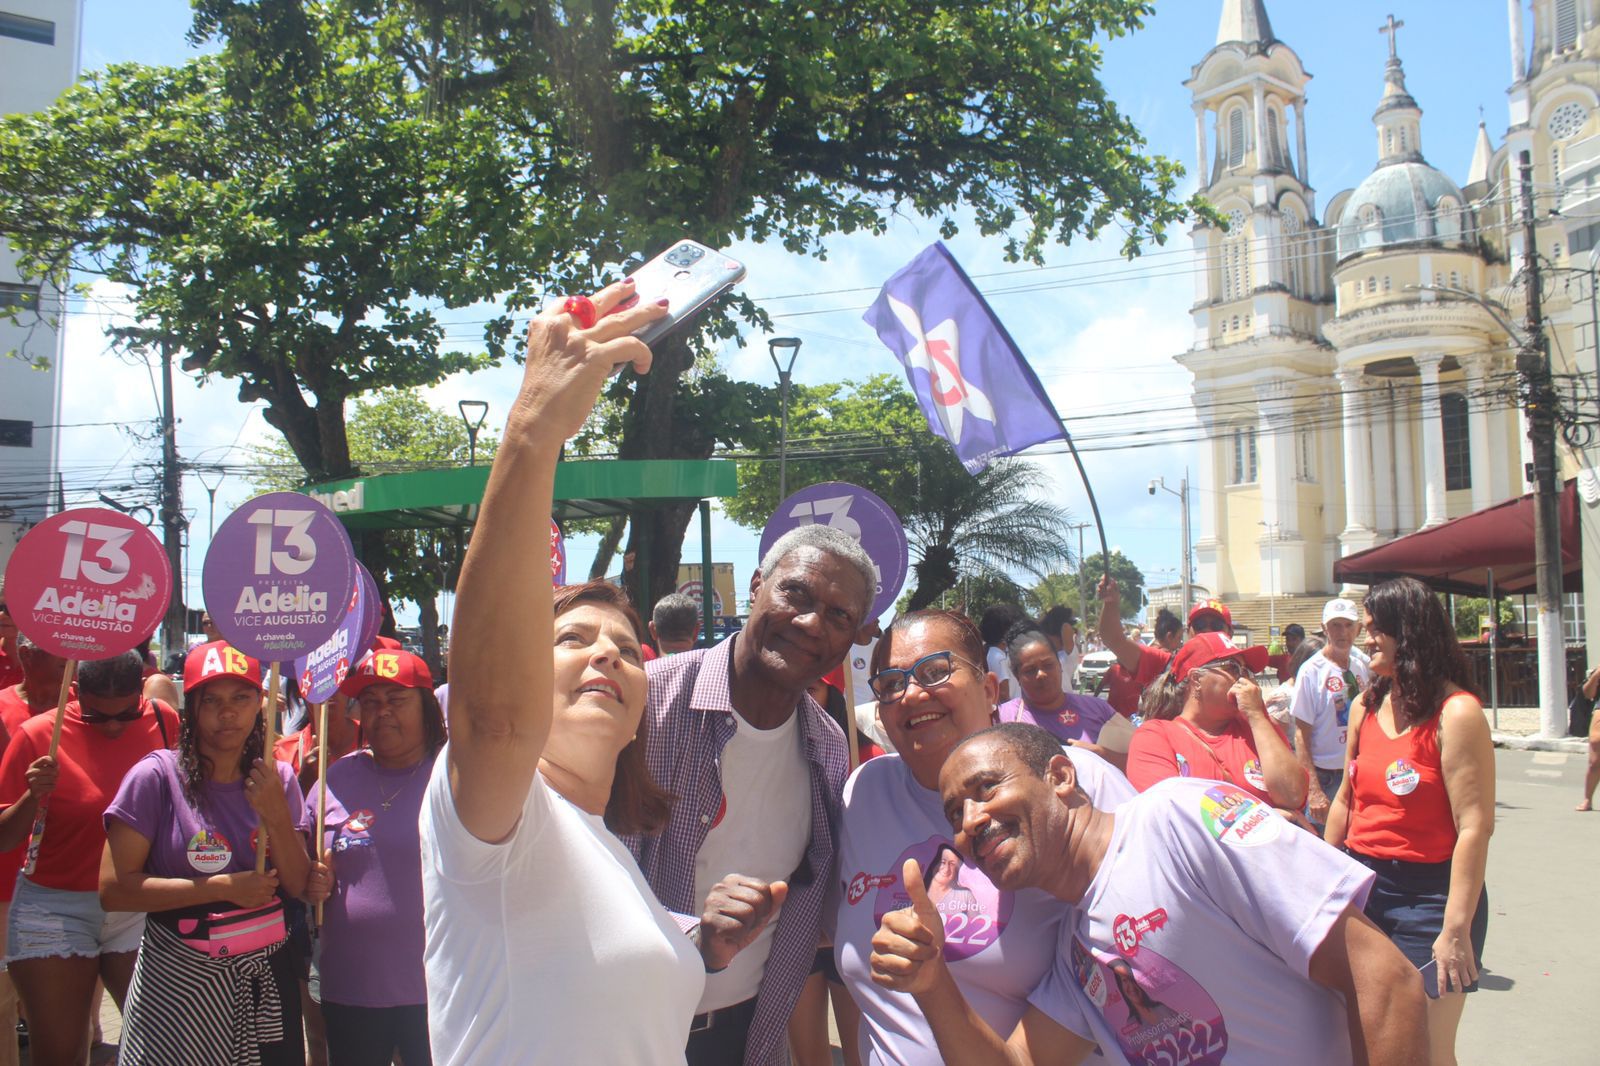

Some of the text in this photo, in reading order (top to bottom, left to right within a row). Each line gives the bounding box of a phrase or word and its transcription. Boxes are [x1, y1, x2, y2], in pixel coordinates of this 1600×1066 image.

[58, 519, 135, 585] 13
[247, 508, 317, 575] 13
[63, 583, 113, 595] PREFEITA
[234, 585, 328, 614] Adelia
[33, 586, 137, 622] Adelia
[32, 612, 133, 633] VICE AUGUSTÃO
[234, 612, 327, 627] VICE AUGUSTÃO
[52, 631, 96, 643] A chave da
[255, 633, 263, 641] A
[262, 633, 285, 641] chave
[305, 628, 349, 670] Adelia
[202, 646, 249, 677] A13
[949, 901, 987, 912] Gleide
[1116, 919, 1137, 951] 13
[1127, 1021, 1169, 1048] Professora
